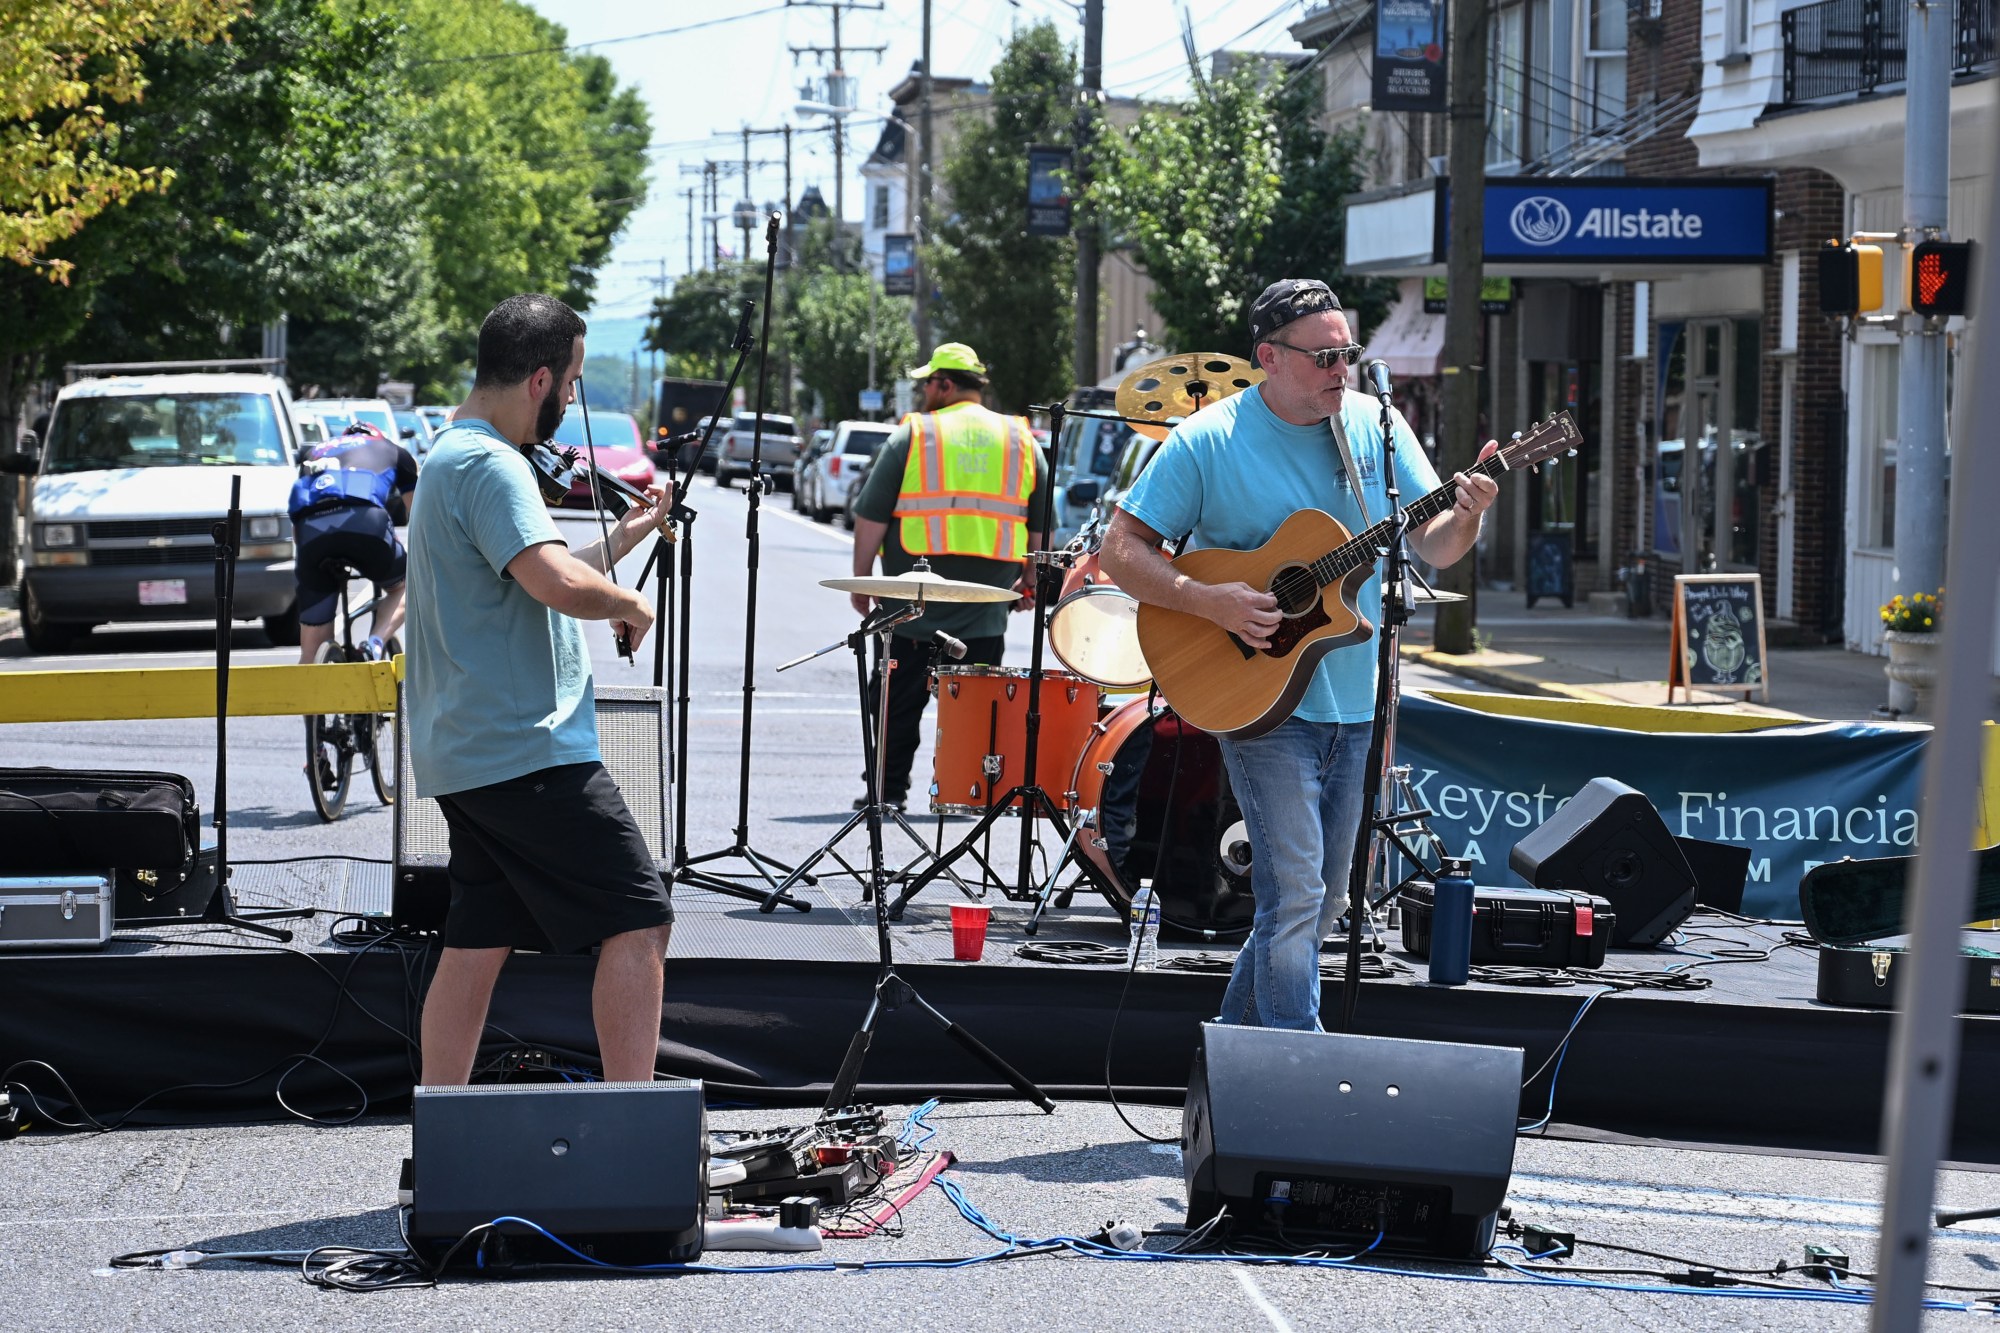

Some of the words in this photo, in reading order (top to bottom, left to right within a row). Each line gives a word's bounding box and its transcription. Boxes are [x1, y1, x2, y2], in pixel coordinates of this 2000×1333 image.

[1575, 207, 1703, 239] Allstate
[957, 452, 988, 475] POLICE
[1678, 791, 1921, 847] Financia
